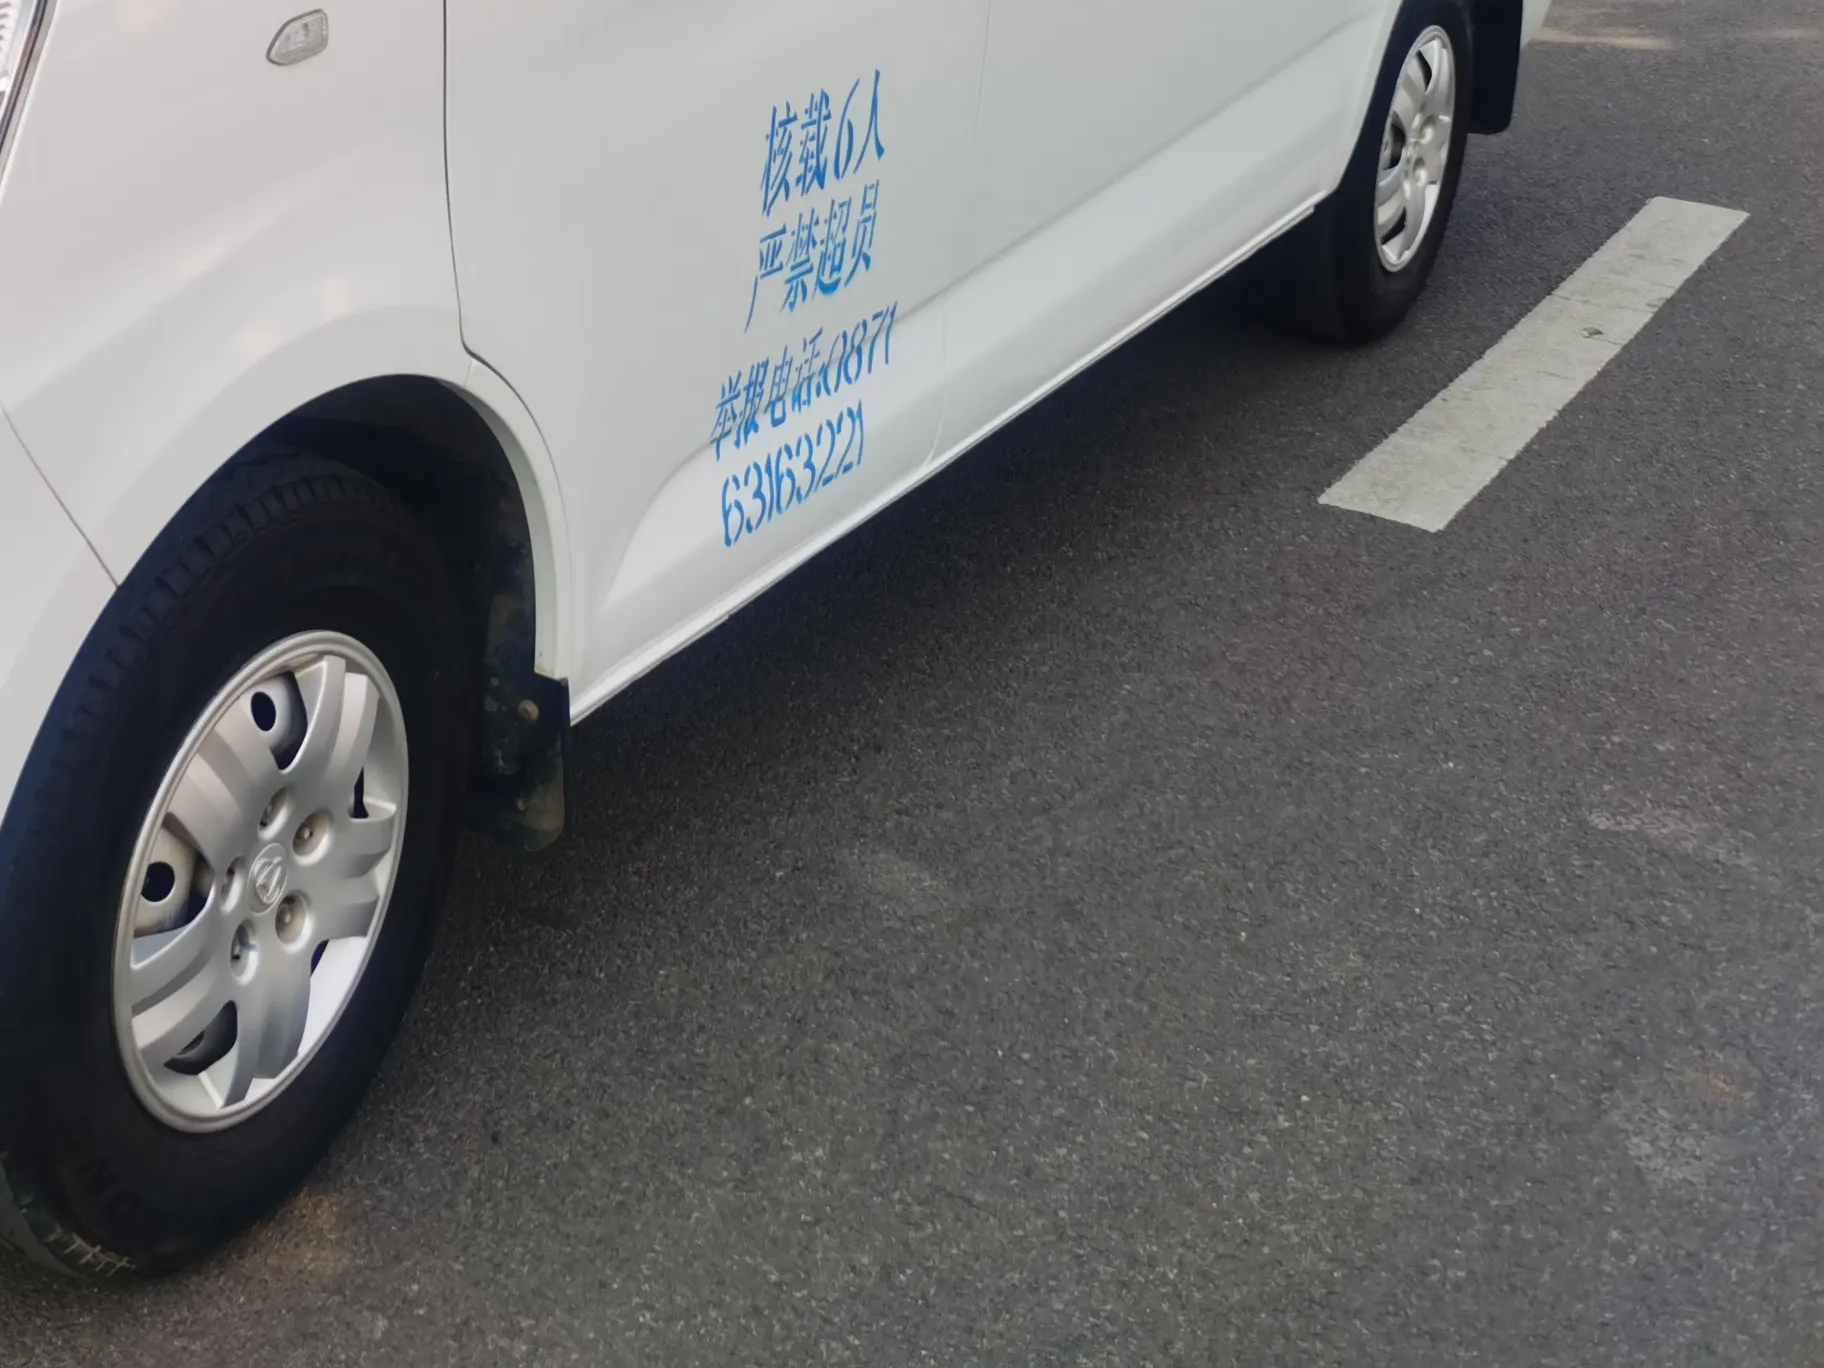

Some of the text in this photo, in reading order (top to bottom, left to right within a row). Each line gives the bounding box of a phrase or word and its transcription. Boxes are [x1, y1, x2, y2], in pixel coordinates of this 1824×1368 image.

[760, 68, 885, 216] 核载6人
[744, 179, 880, 334] 严禁超员
[721, 398, 865, 548] 63163221
